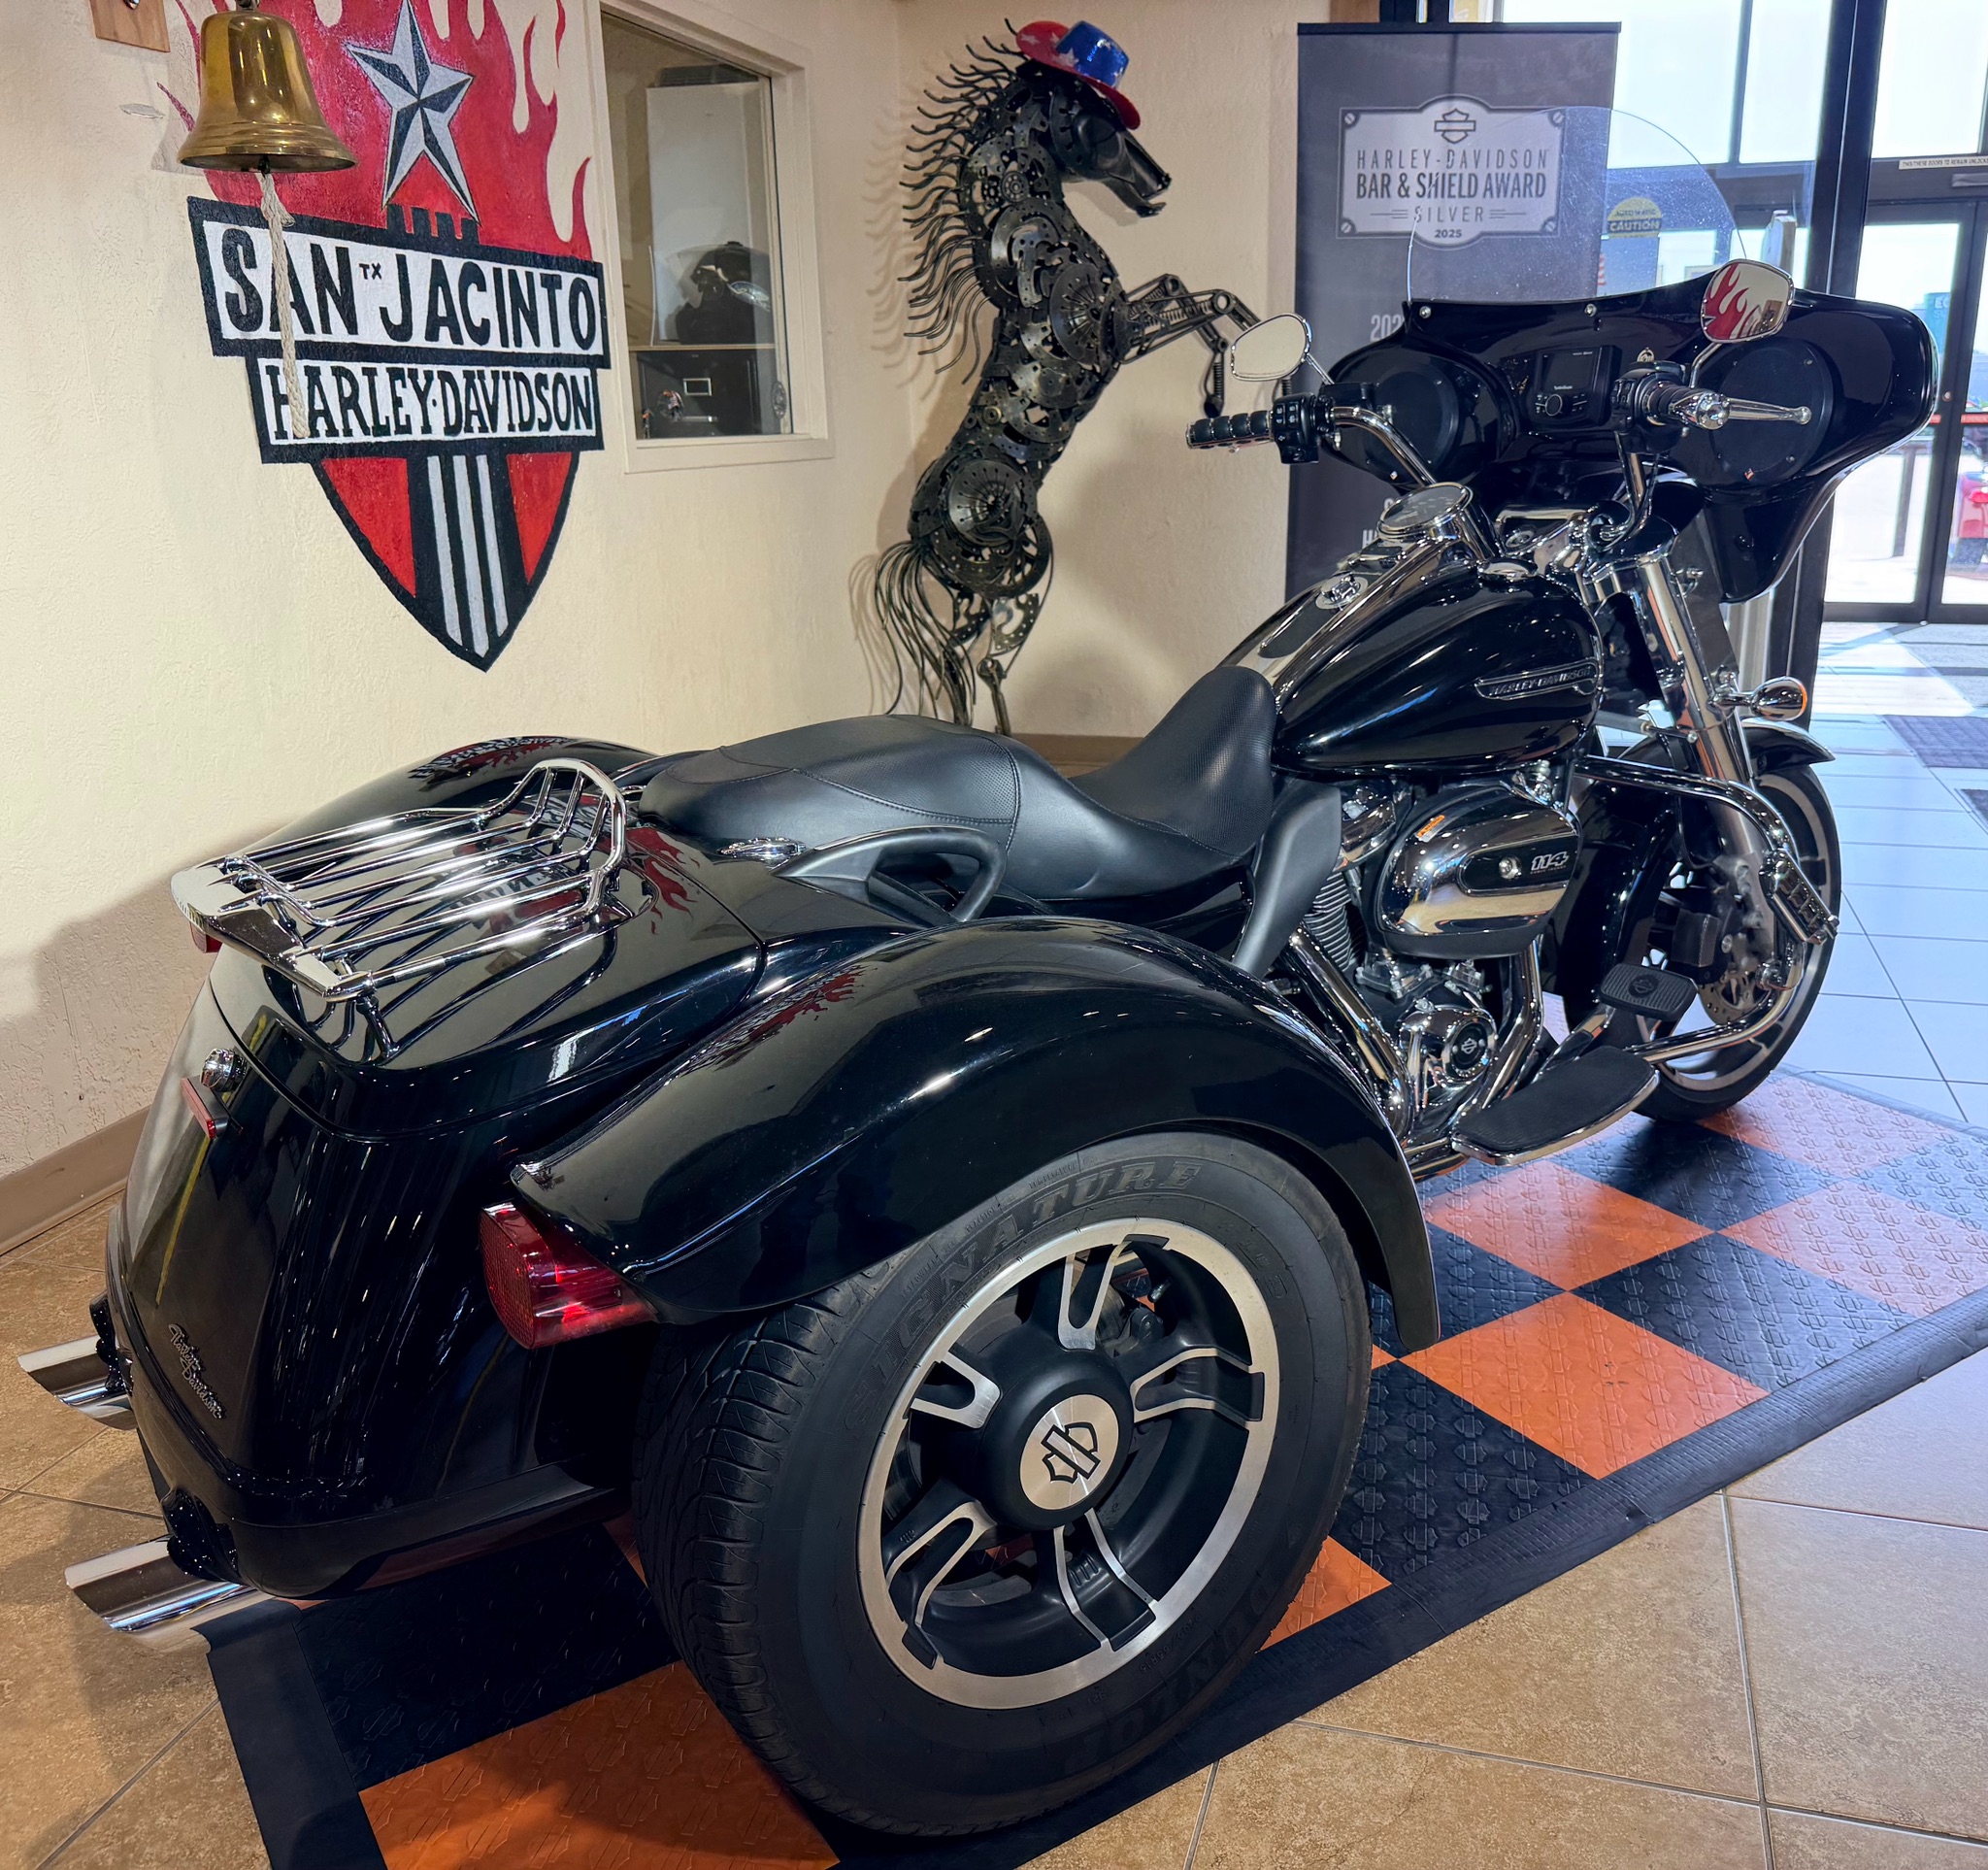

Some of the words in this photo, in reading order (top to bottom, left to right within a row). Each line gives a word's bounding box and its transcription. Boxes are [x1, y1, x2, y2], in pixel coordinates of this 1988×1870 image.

[1357, 149, 1547, 170] HARLEY-DAVIDSON
[1356, 172, 1391, 199] BAR
[1398, 172, 1410, 199] &
[1415, 172, 1478, 199] SHIELD
[1482, 172, 1547, 199] AWARD
[1413, 205, 1484, 223] SILVER
[1434, 228, 1462, 239] 2025
[1609, 219, 1661, 232] CAUTION
[221, 227, 359, 336] SAN
[358, 262, 382, 280] TX
[380, 253, 596, 351] JACINTO
[1370, 314, 1405, 343] 202
[1531, 851, 1570, 871] 114
[844, 1159, 1204, 1431] SIGNATURE
